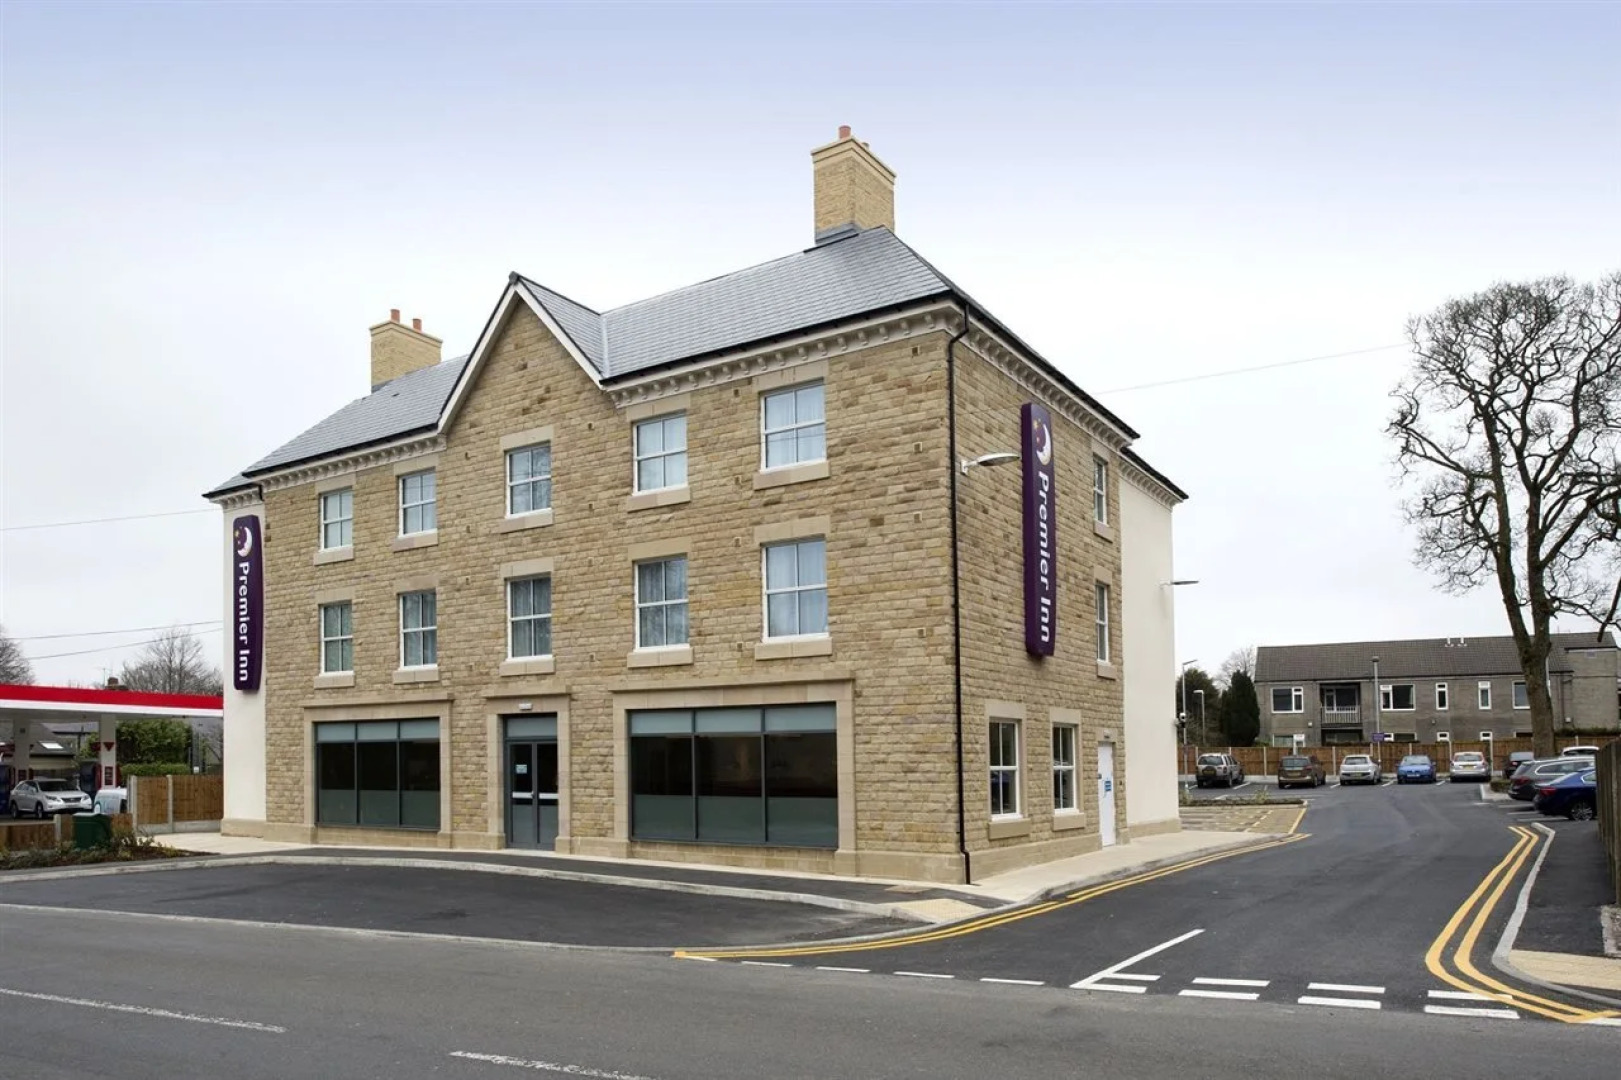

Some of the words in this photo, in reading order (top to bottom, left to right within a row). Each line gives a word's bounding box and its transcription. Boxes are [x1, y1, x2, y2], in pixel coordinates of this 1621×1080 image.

[1038, 470, 1051, 591] Premier
[238, 562, 250, 645] Premier
[1040, 598, 1051, 643] Inn
[238, 650, 250, 682] Inn
